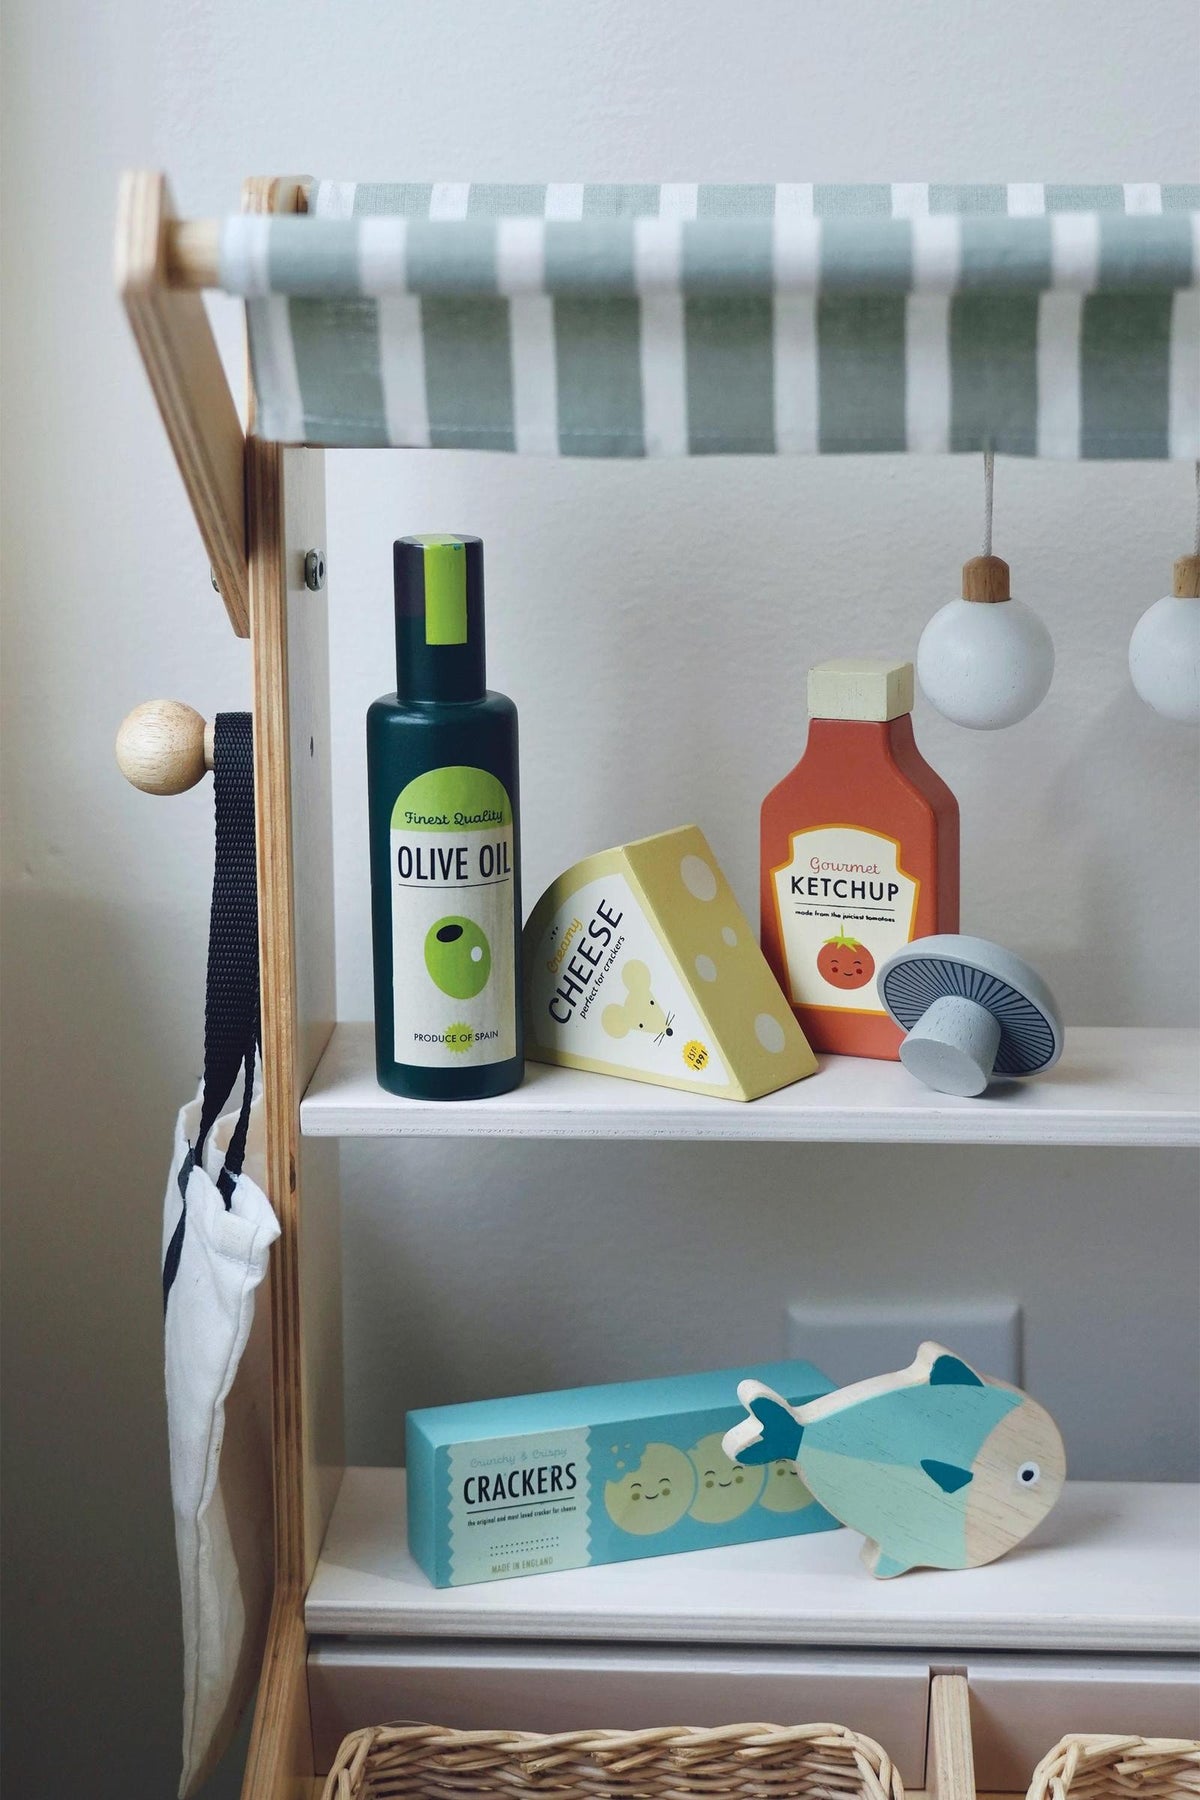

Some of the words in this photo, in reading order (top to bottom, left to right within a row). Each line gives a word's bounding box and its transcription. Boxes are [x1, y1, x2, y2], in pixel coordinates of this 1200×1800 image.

[404, 811, 450, 825] Finest
[453, 809, 503, 825] Quality
[397, 845, 468, 880] OLIVE
[479, 841, 511, 878] OIL
[810, 856, 880, 874] Gourmet
[791, 875, 899, 901] KETCHUP
[546, 918, 583, 973] Creamy
[548, 899, 623, 1024] CHEESE
[579, 987, 599, 1019] perfect
[594, 972, 605, 987] for
[604, 935, 625, 972] crackers
[414, 1033, 457, 1043] PRODUCE
[459, 1034, 472, 1042] OF
[474, 1030, 499, 1041] SPAIN
[693, 1049, 708, 1070] 1991
[470, 1454, 515, 1468] Crunchy
[532, 1447, 568, 1460] Crispy
[463, 1462, 577, 1505] CRACKERS
[467, 1518, 476, 1527] the
[476, 1516, 496, 1526] original
[534, 1508, 552, 1517] cracker
[491, 1564, 511, 1574] MADE
[521, 1556, 554, 1570] ENGLAND
